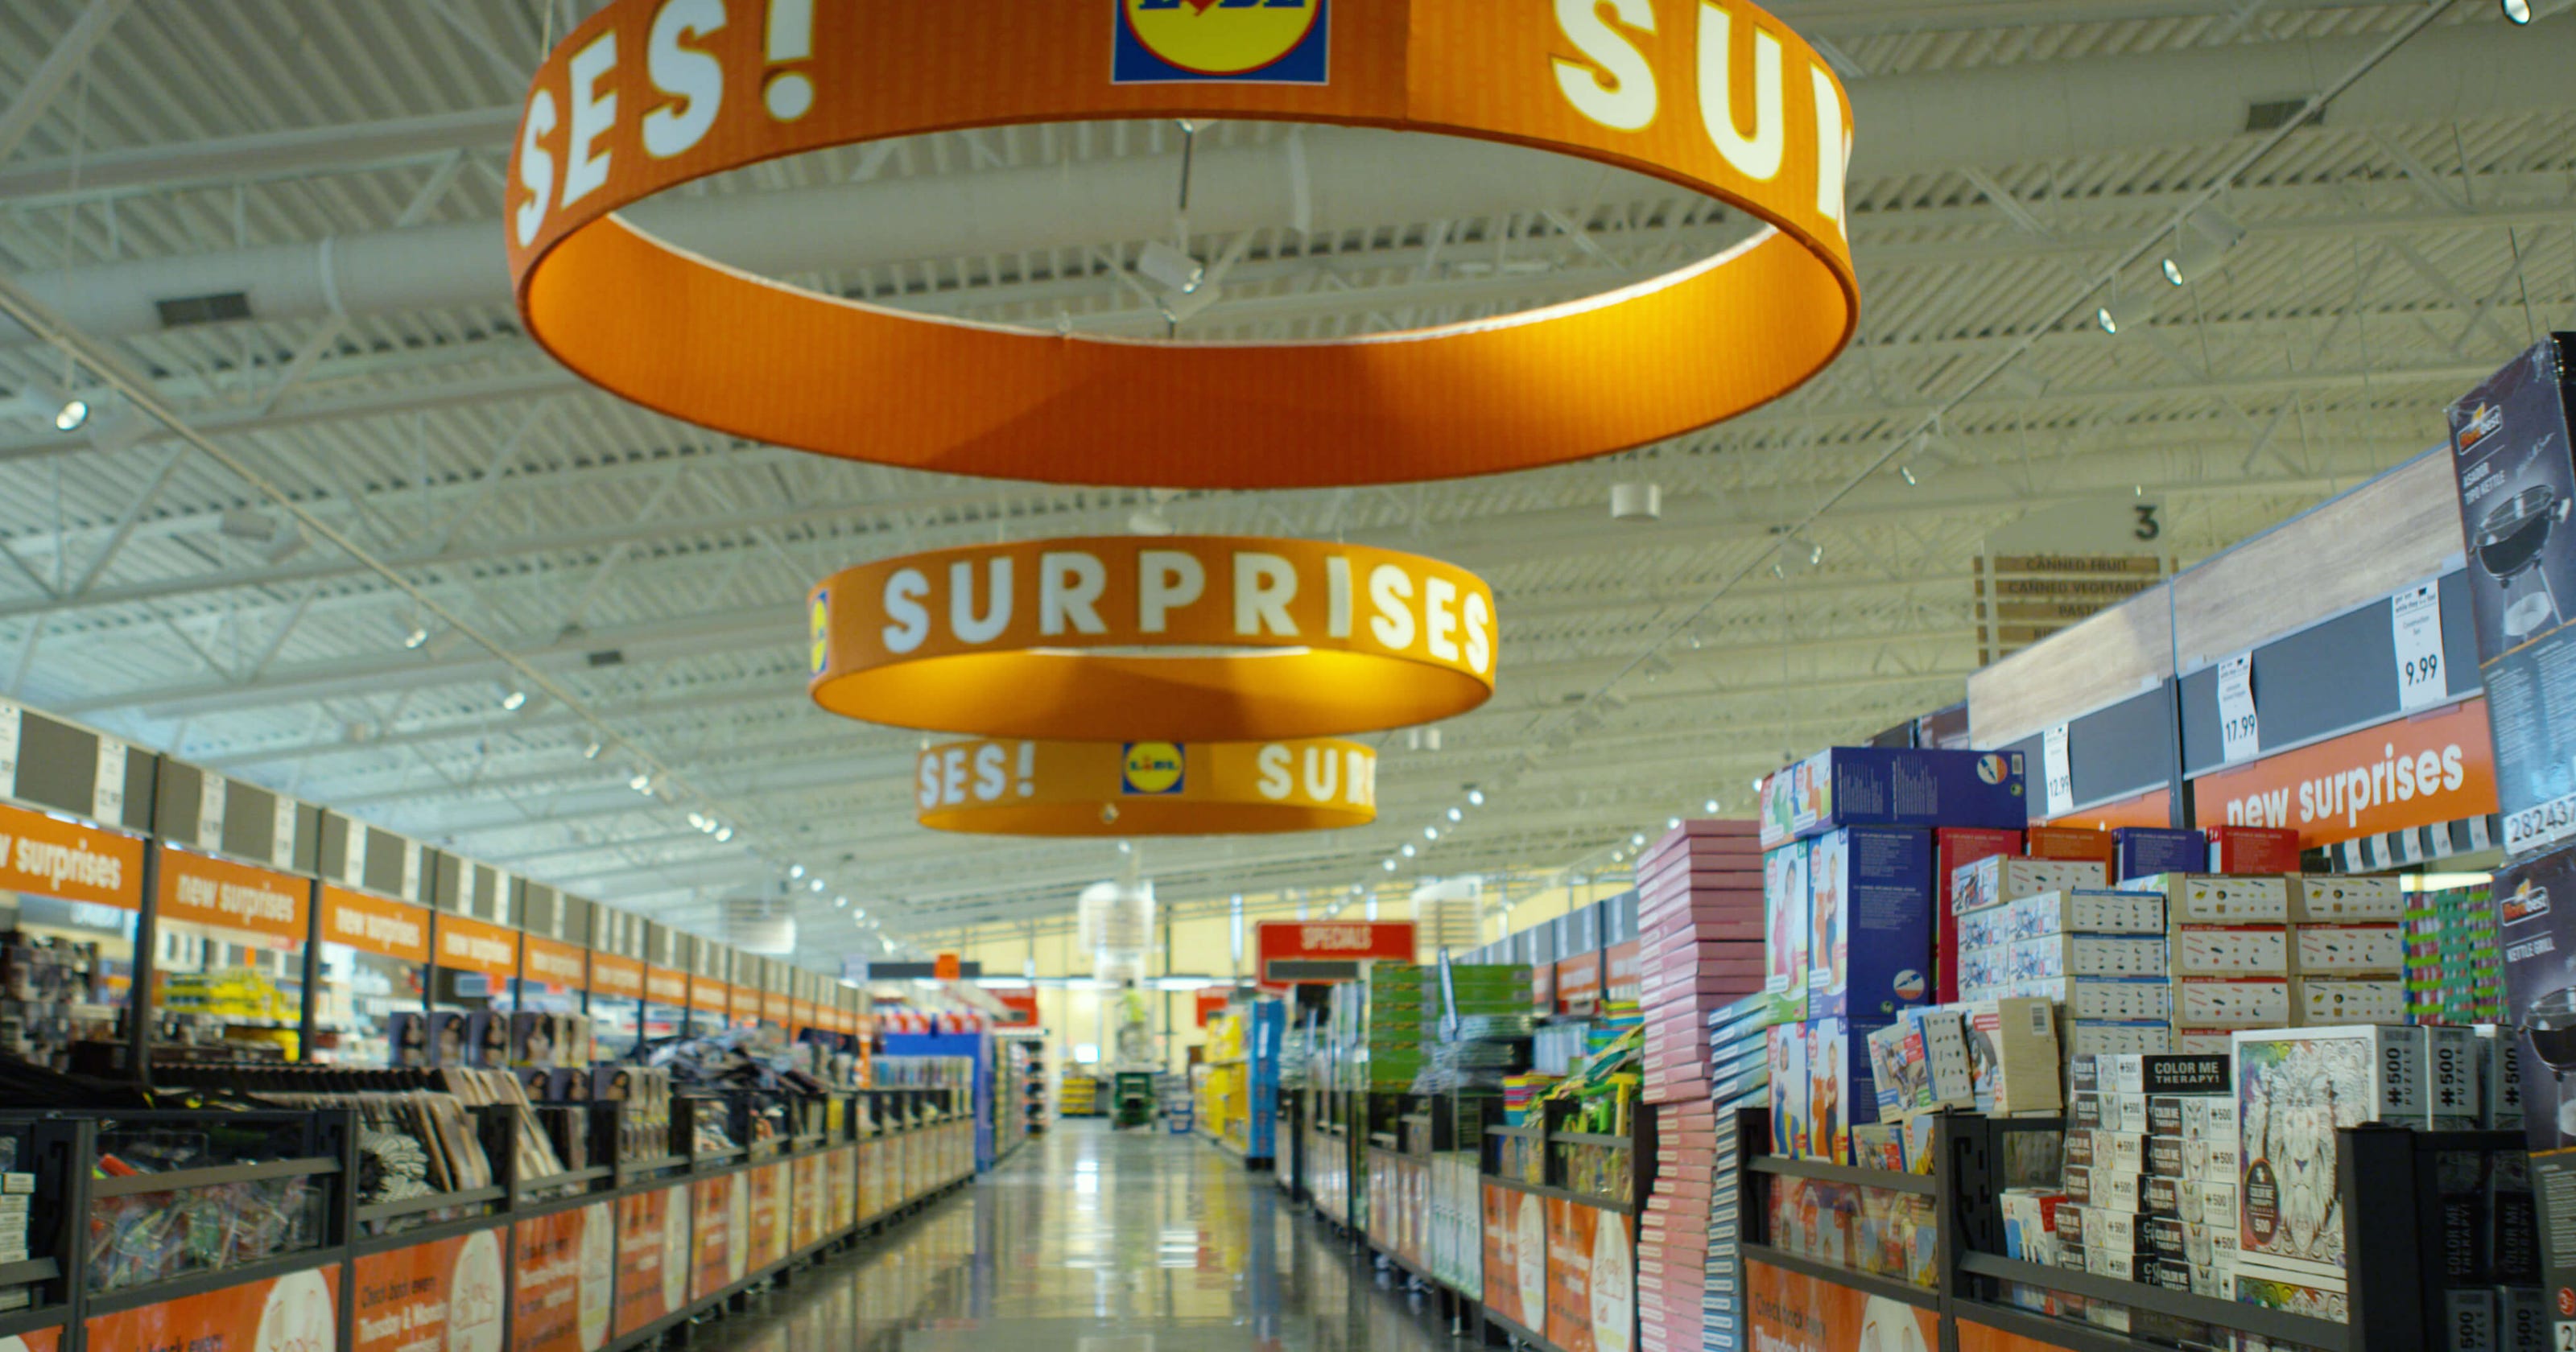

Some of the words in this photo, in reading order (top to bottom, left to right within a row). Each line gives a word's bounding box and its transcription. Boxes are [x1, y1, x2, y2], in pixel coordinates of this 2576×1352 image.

[2135, 505, 2159, 540] 3
[2026, 559, 2085, 571] CANNED
[2090, 559, 2128, 571] FRUIT
[2008, 583, 2067, 594] CANNED
[882, 550, 1491, 674] SURPRISES
[2405, 653, 2438, 686] 9.99
[2226, 714, 2255, 742] 17.99
[2050, 775, 2070, 798] 12.99
[2227, 784, 2289, 827] new
[2299, 742, 2464, 828] surprises
[15, 839, 122, 891] surprises
[175, 874, 218, 909] new
[219, 880, 295, 925] surprises
[1301, 927, 1372, 950] SPECIALS
[2154, 1061, 2195, 1074] COLOR
[2198, 1061, 2219, 1074] ME
[2155, 1074, 2220, 1084] THERAPY!
